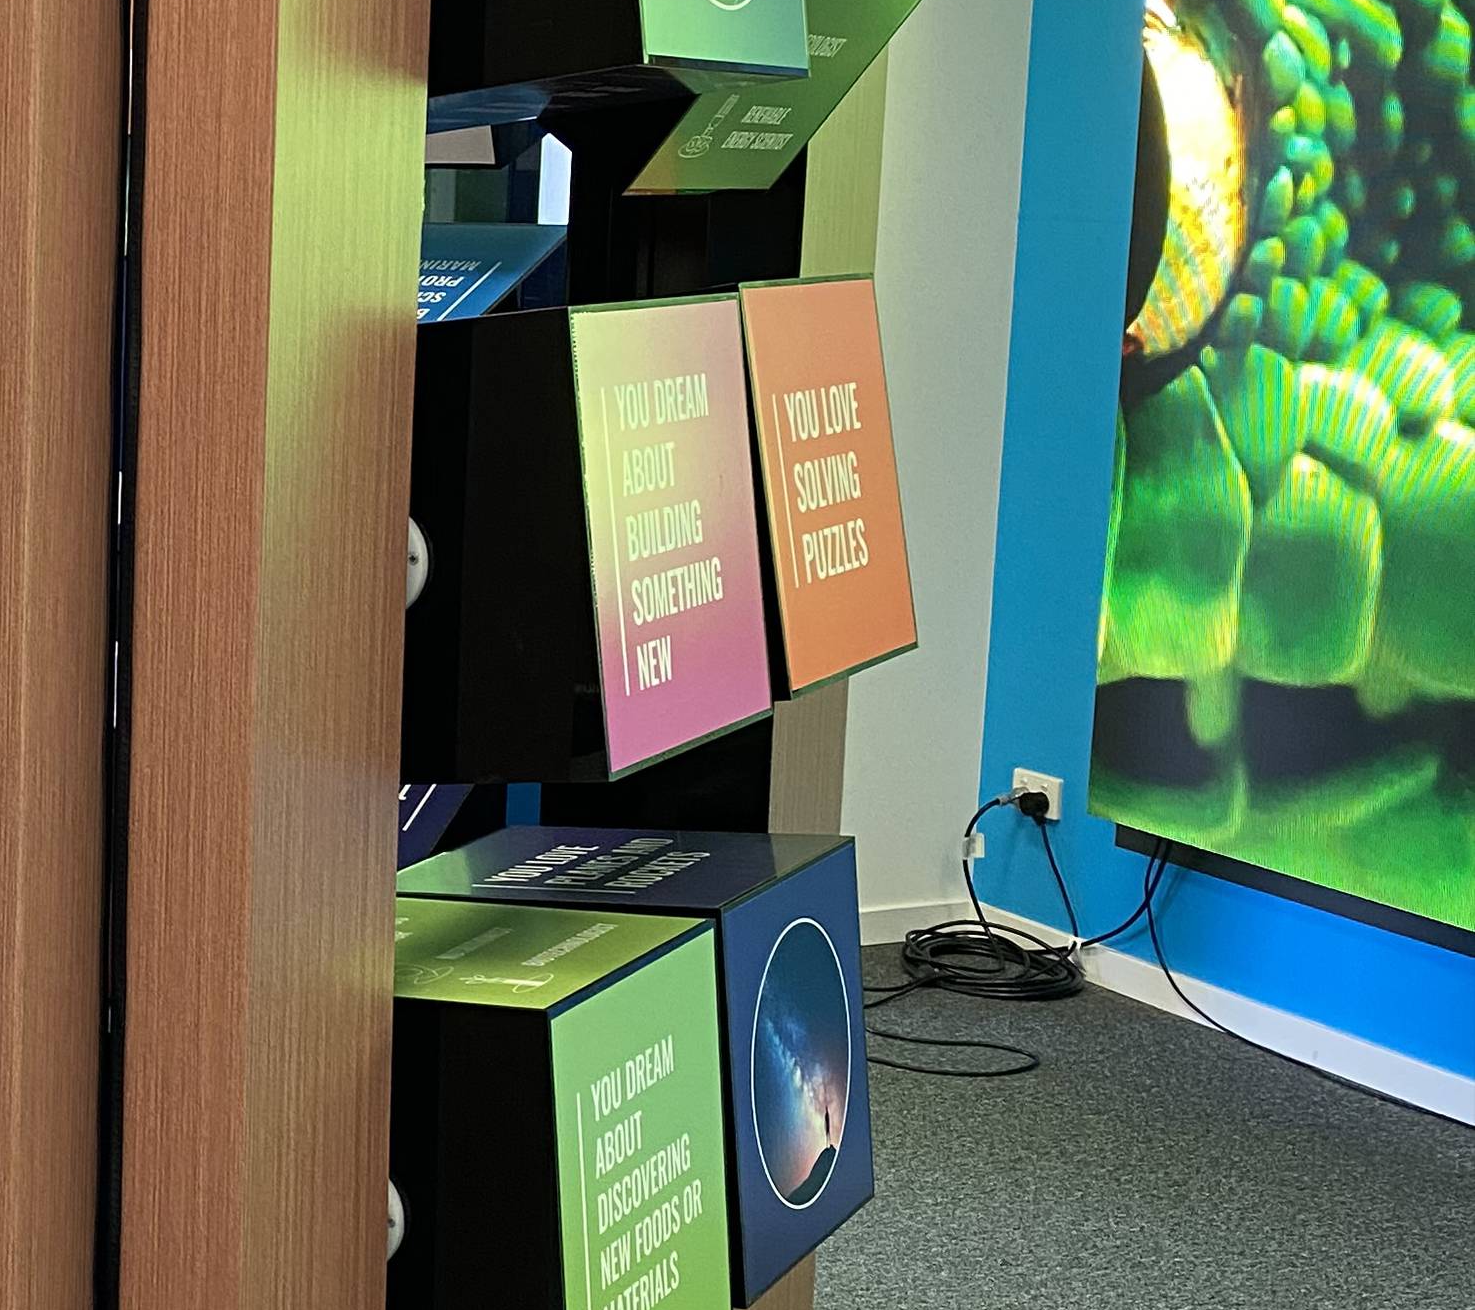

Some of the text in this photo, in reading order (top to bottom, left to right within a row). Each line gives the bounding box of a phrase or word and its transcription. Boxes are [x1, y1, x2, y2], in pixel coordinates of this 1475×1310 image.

[614, 373, 709, 431] YOU DREAM
[784, 382, 861, 442] YOU LOVE
[623, 442, 675, 496] ABOUT
[794, 451, 861, 513] SOLVING
[627, 499, 703, 562] BUILDING
[803, 518, 868, 585] PUZZLES
[631, 556, 723, 626] SOMETHING
[637, 635, 672, 691] NEW
[483, 844, 600, 882] YOU LOVE
[543, 837, 674, 886] PLANES AND
[603, 851, 711, 888] ROCKETS
[591, 1035, 675, 1123] YOU DREAM
[595, 1111, 642, 1179] ABOUT
[597, 1134, 691, 1235] DISCOVERING
[601, 1181, 702, 1290] NEW FOODS OR
